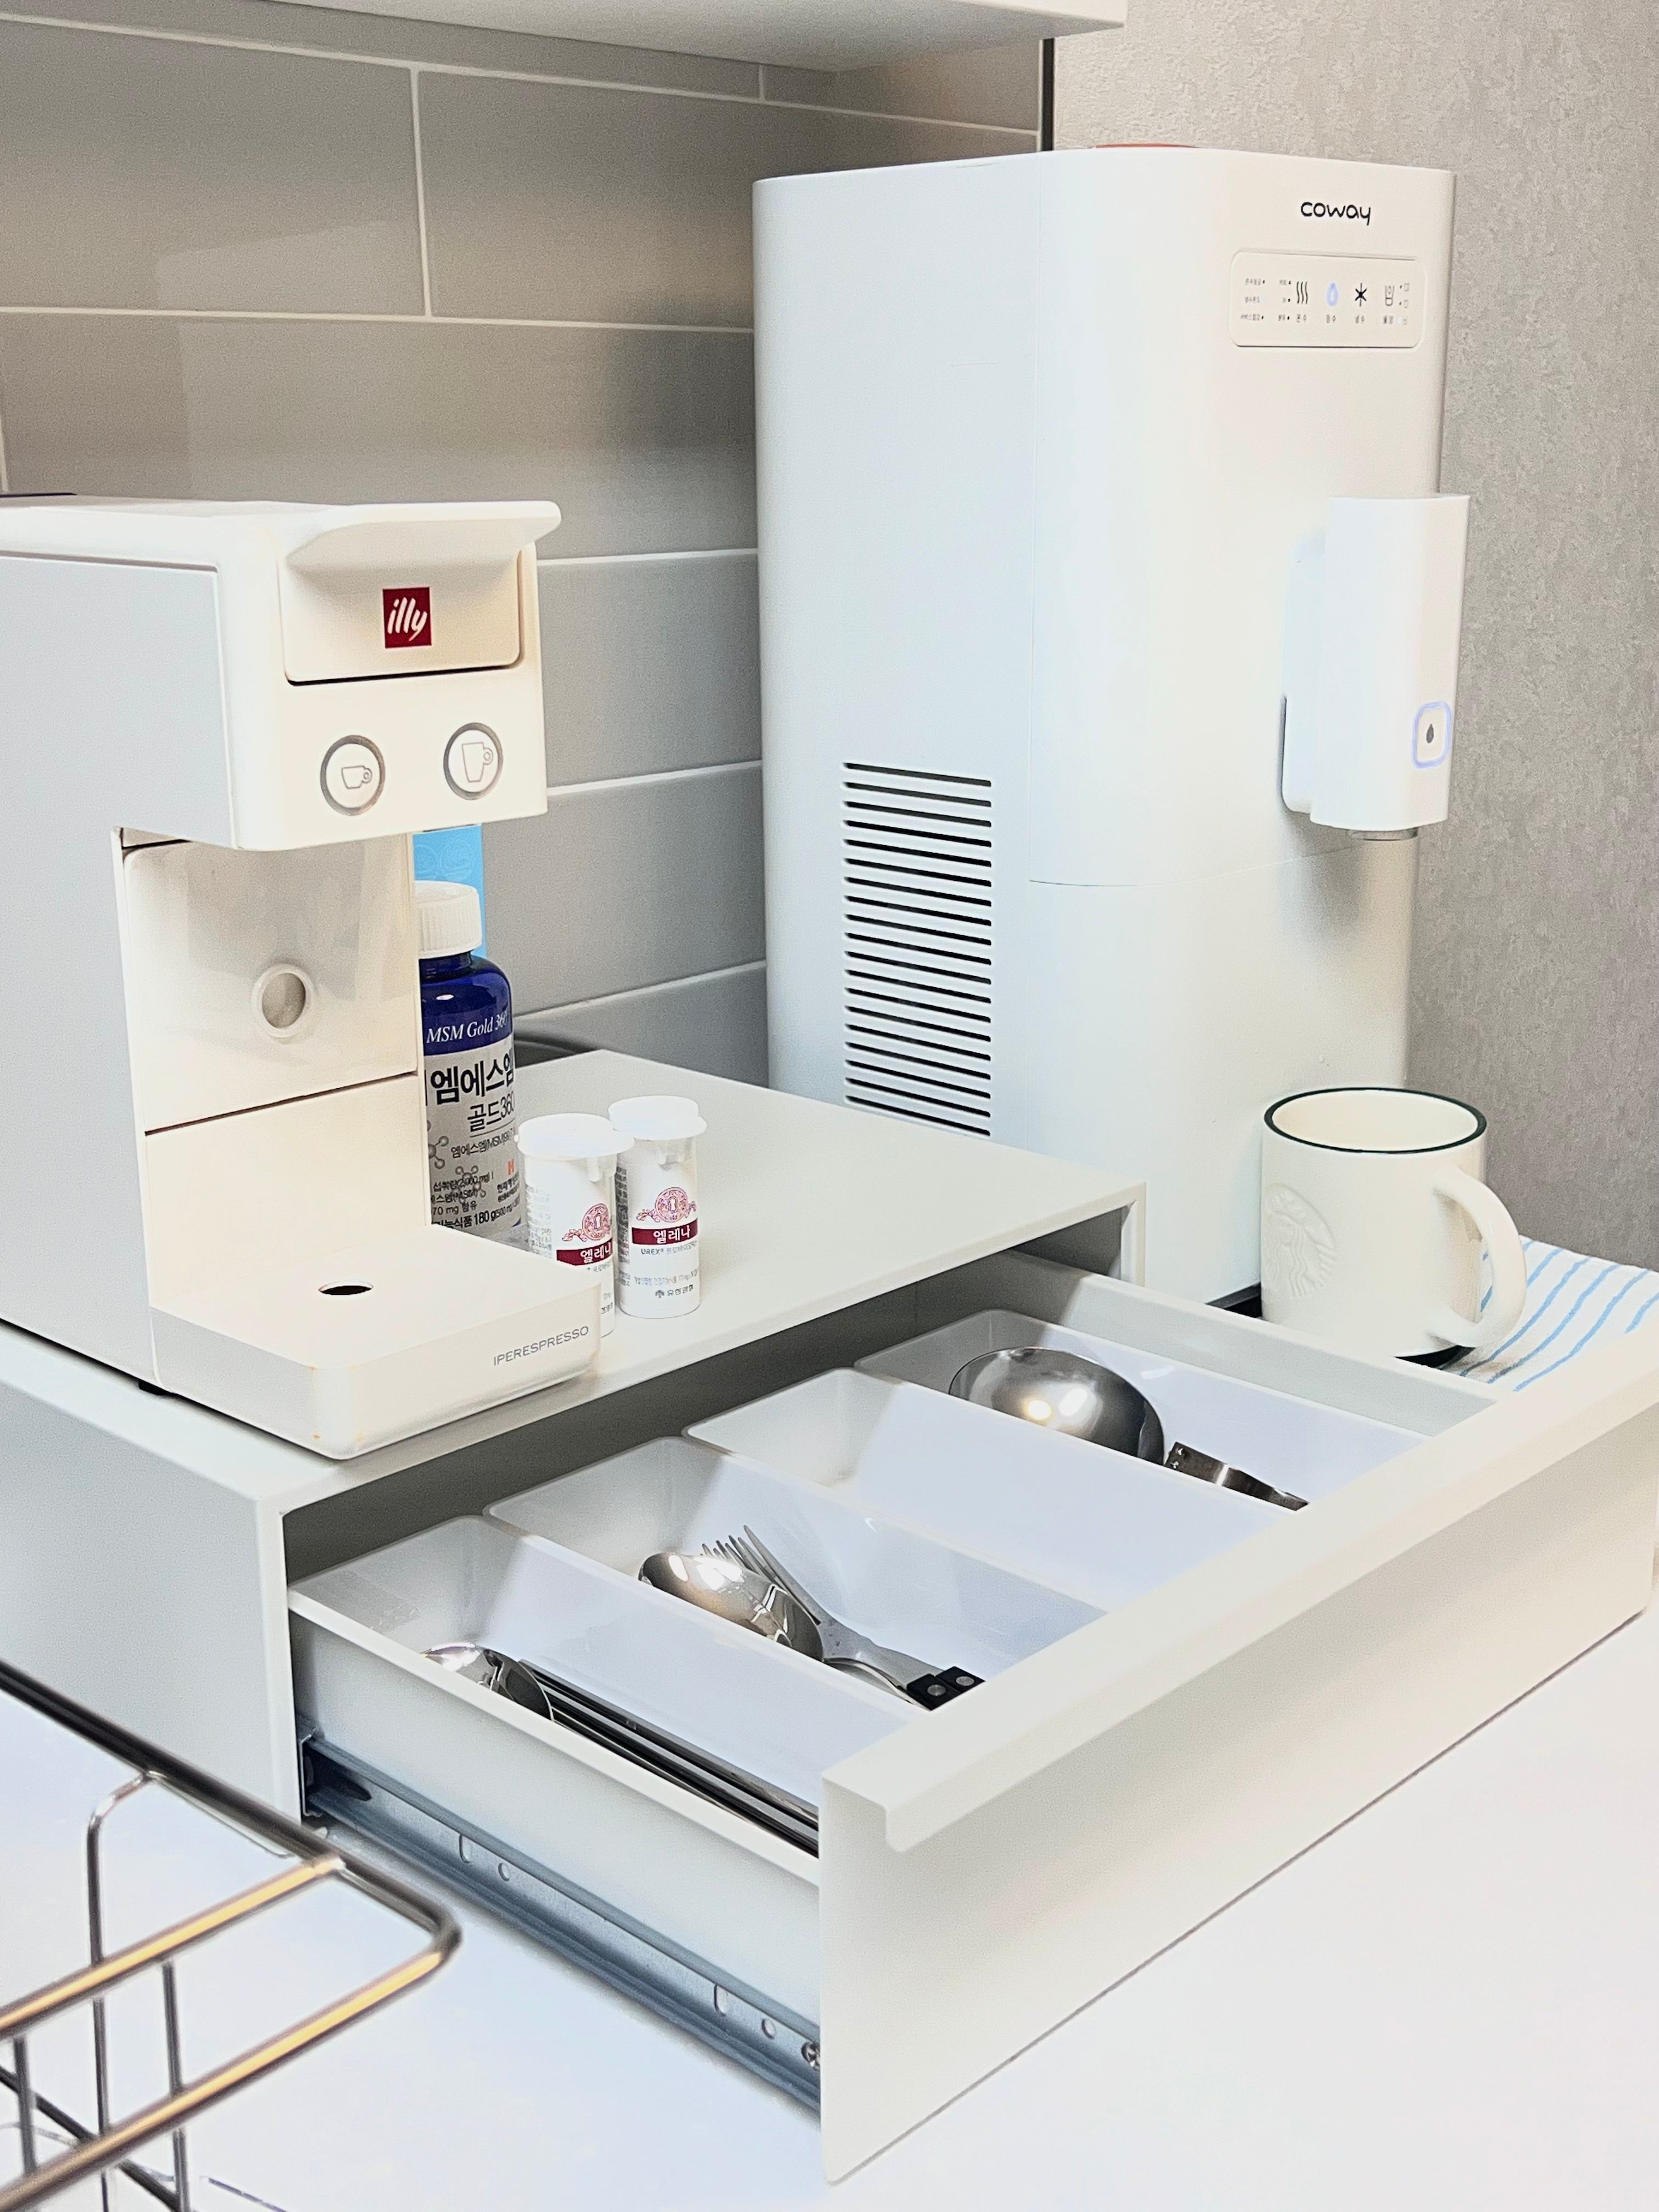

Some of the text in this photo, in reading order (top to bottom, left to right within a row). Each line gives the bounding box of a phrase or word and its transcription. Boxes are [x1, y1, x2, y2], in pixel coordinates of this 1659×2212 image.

[1301, 202, 1371, 226] coway
[388, 597, 428, 642] illy
[426, 1024, 465, 1043] MSM
[467, 1016, 494, 1037] Gold
[445, 1205, 459, 1215] mg
[653, 1225, 691, 1244] 엘레나
[493, 1325, 589, 1366] IPERESPRESSO
